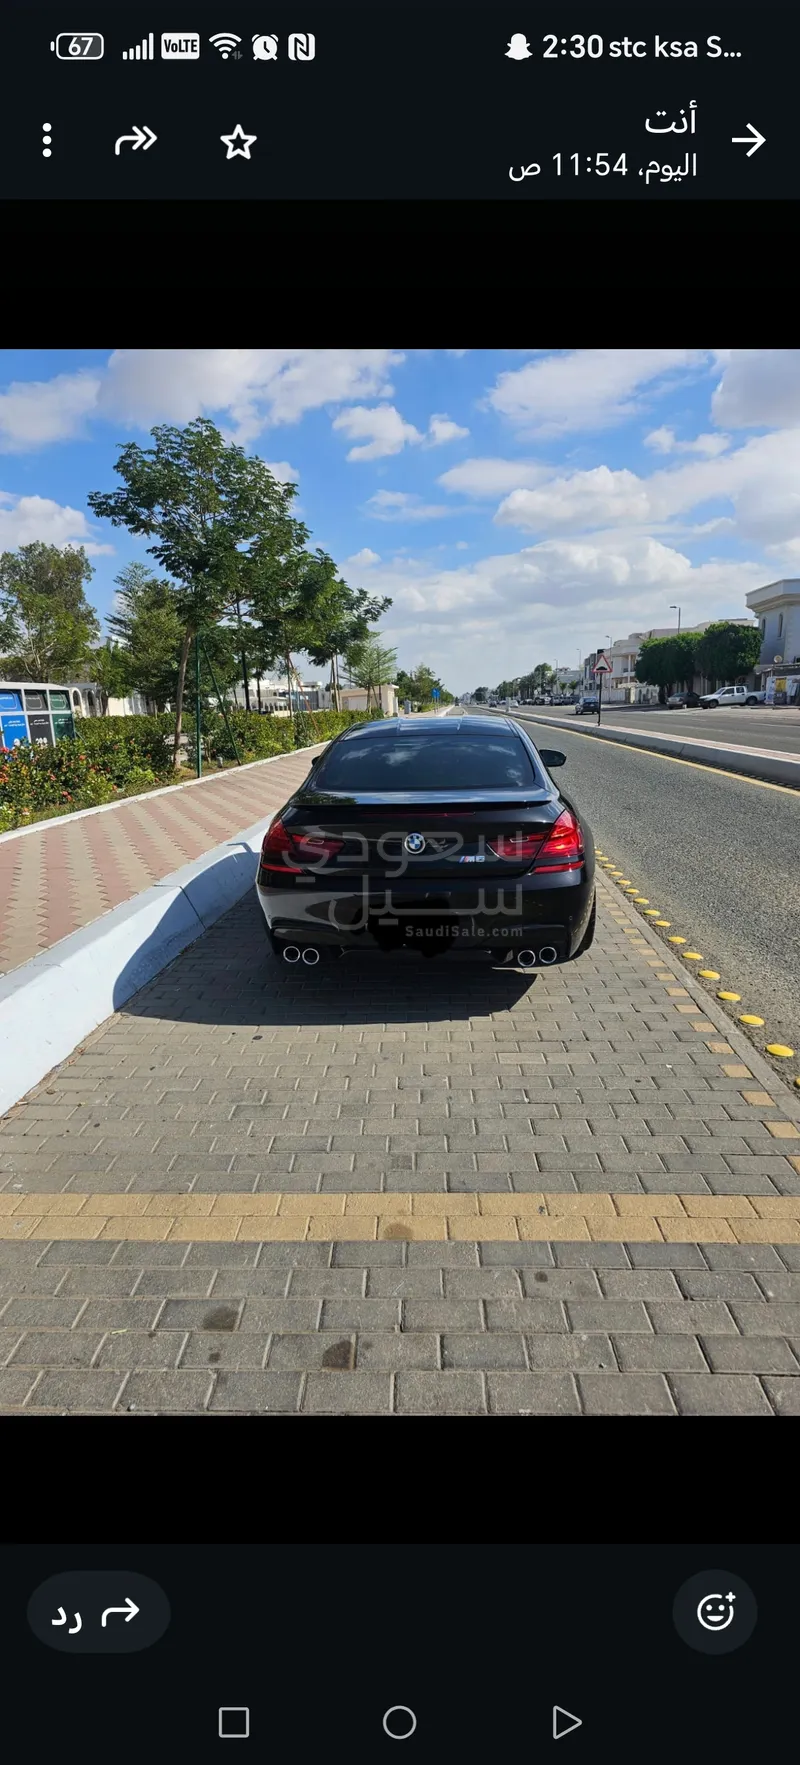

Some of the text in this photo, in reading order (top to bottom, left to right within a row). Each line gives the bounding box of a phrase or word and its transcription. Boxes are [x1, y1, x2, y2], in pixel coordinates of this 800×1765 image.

[69, 37, 93, 55] 67
[164, 39, 197, 52] VoLTE
[543, 35, 603, 58] 2:30
[609, 37, 646, 57] stc
[655, 35, 697, 57] ksa
[645, 101, 697, 133] أنت
[509, 163, 540, 181] ص
[553, 153, 627, 175] 11:54
[52, 1607, 82, 1634] رد
